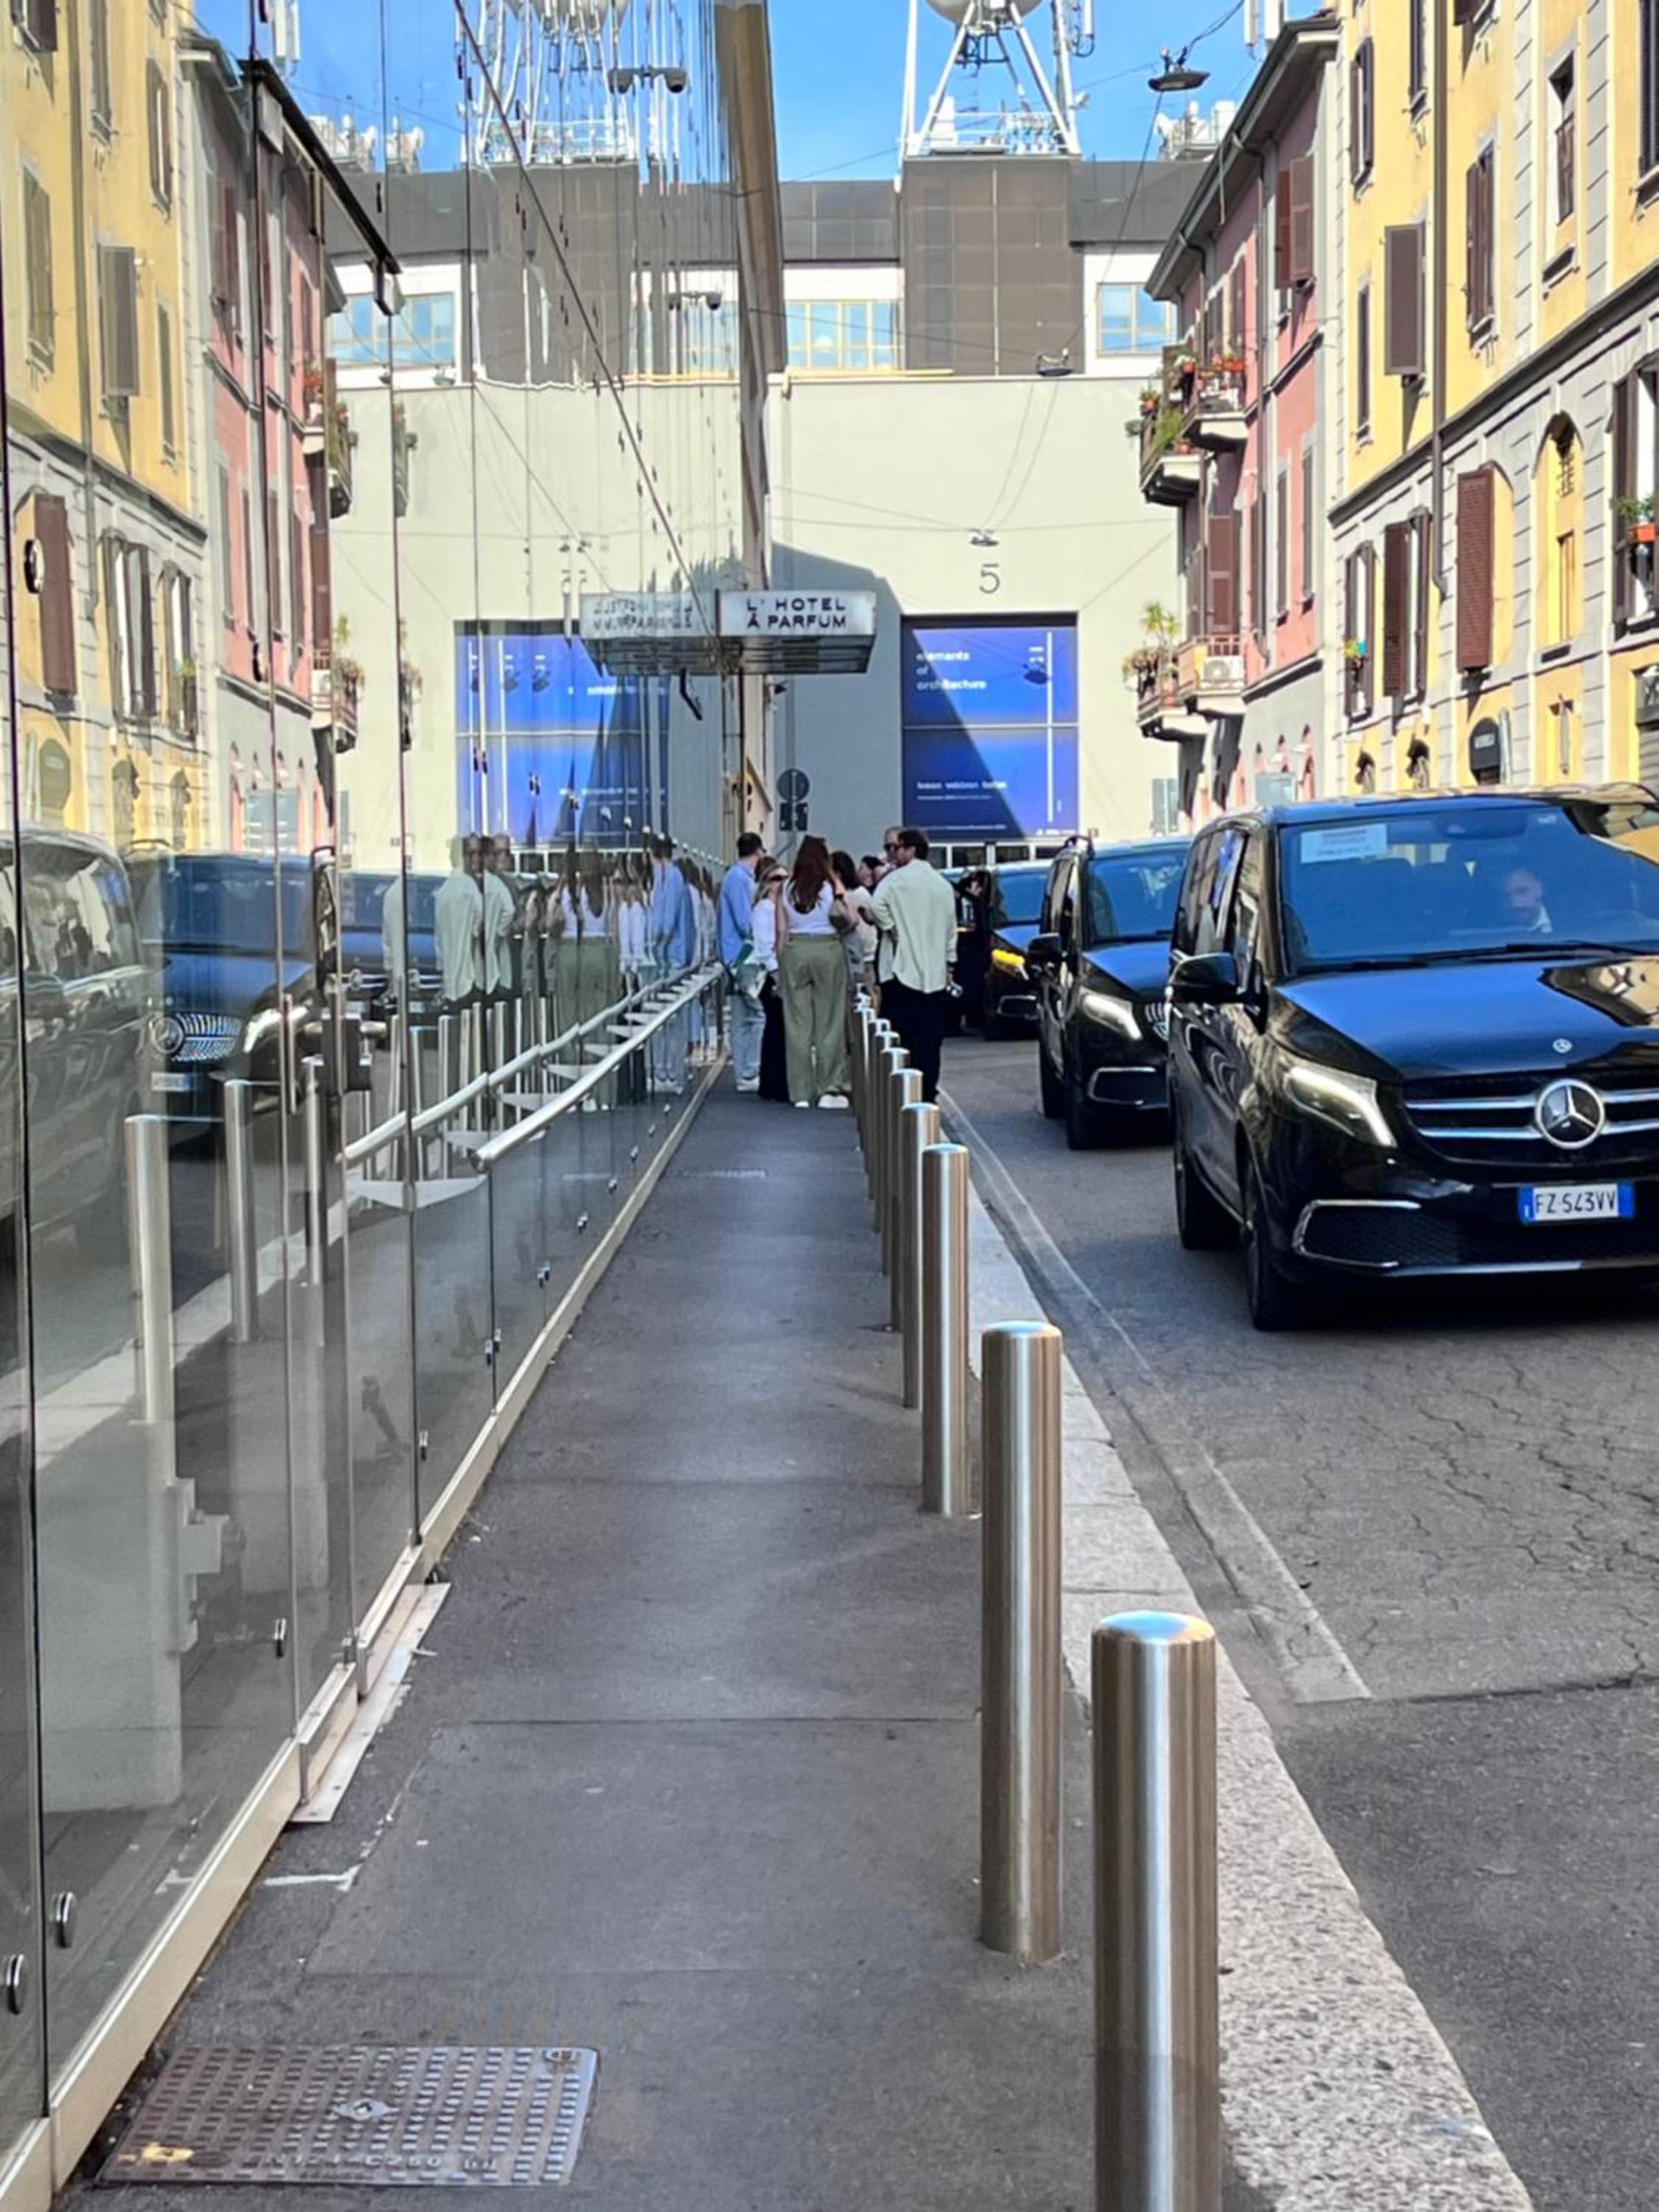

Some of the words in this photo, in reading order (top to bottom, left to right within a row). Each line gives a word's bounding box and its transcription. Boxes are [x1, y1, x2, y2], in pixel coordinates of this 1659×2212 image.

[979, 563, 1001, 594] 5
[776, 597, 846, 611] HOTEL
[768, 614, 846, 628] PARFUM
